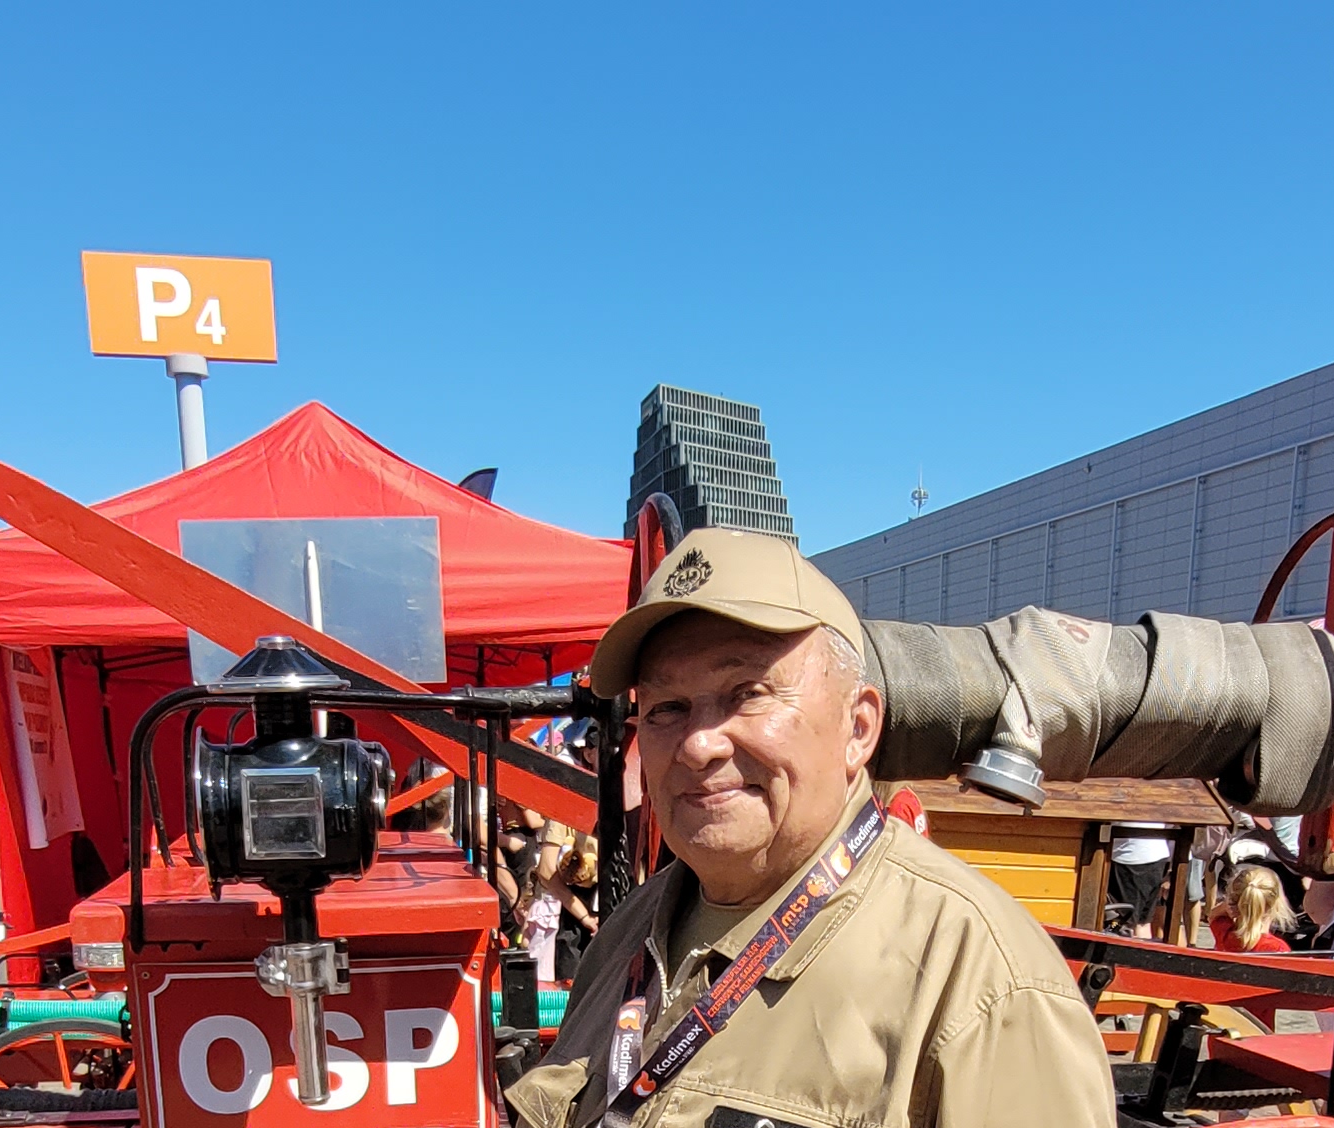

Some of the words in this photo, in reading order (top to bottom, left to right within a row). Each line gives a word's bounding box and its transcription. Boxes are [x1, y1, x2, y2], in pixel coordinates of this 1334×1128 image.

[847, 810, 881, 853] Kadimex
[178, 1007, 460, 1115] OSP
[653, 1024, 704, 1075] Kadimex
